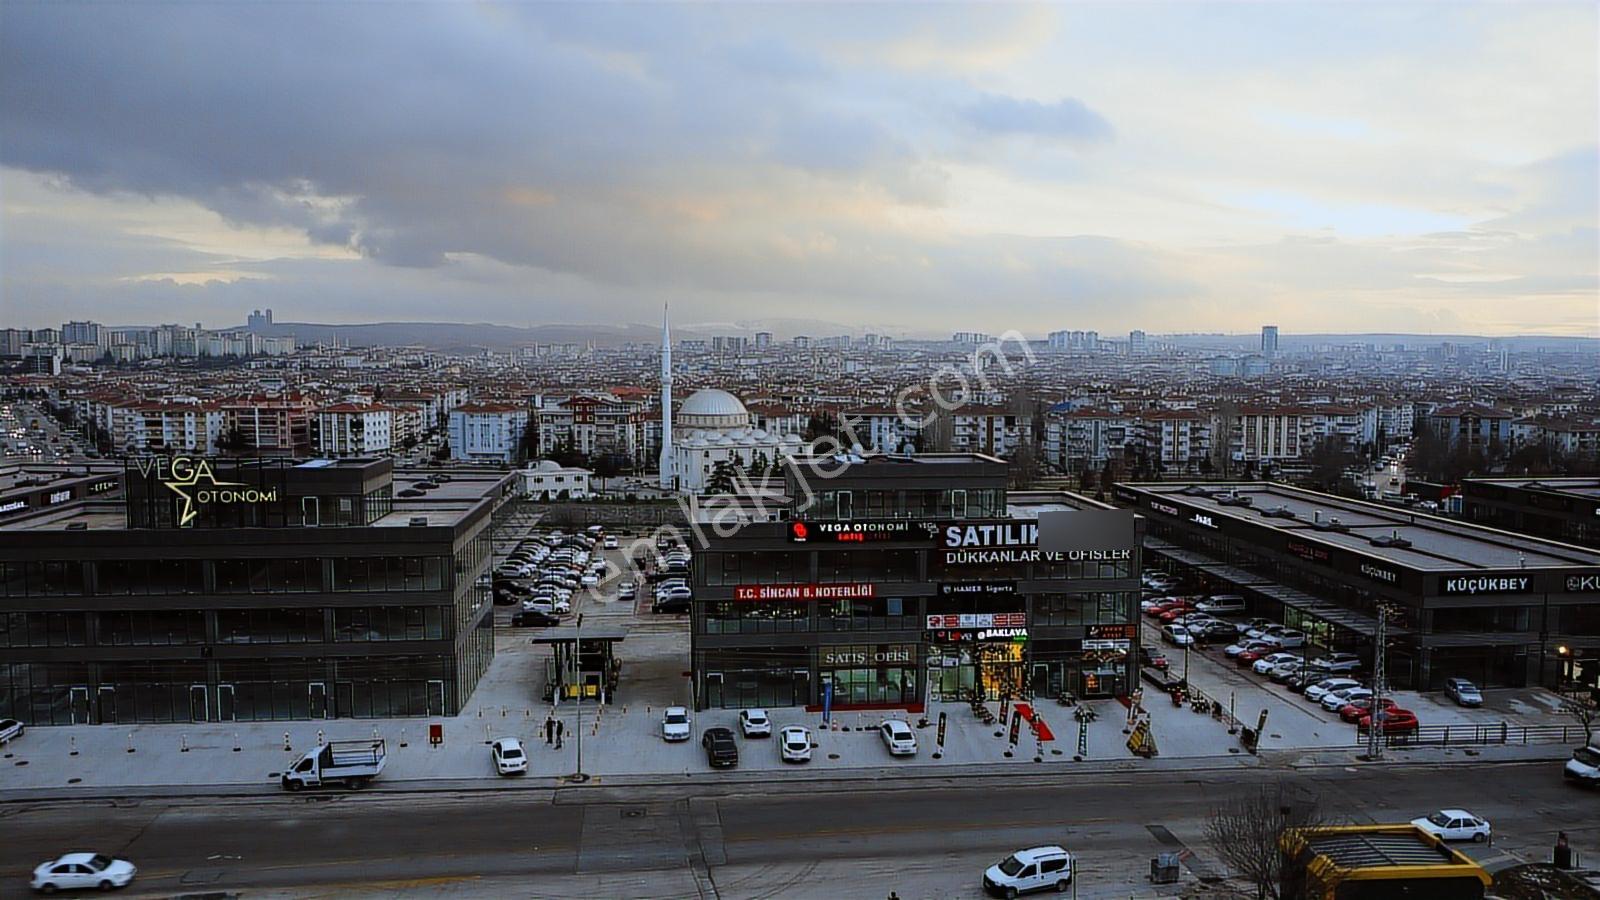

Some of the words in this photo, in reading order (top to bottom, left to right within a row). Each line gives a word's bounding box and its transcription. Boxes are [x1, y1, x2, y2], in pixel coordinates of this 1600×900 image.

[136, 457, 216, 480] VEGA
[197, 486, 277, 503] OTONOMİ
[819, 523, 850, 532] VEGA
[853, 520, 909, 532] OTONOMİ
[946, 548, 1040, 563] DÜKKANLAR
[1045, 551, 1064, 561] VE
[738, 588, 758, 599] T.C.
[759, 585, 800, 598] SİNCAN
[815, 584, 873, 597] NOTERLİĞİ
[1446, 577, 1529, 594] KÜÇÜKBEY
[825, 652, 866, 664] SATIŞ
[874, 649, 910, 662] OFİSİ
